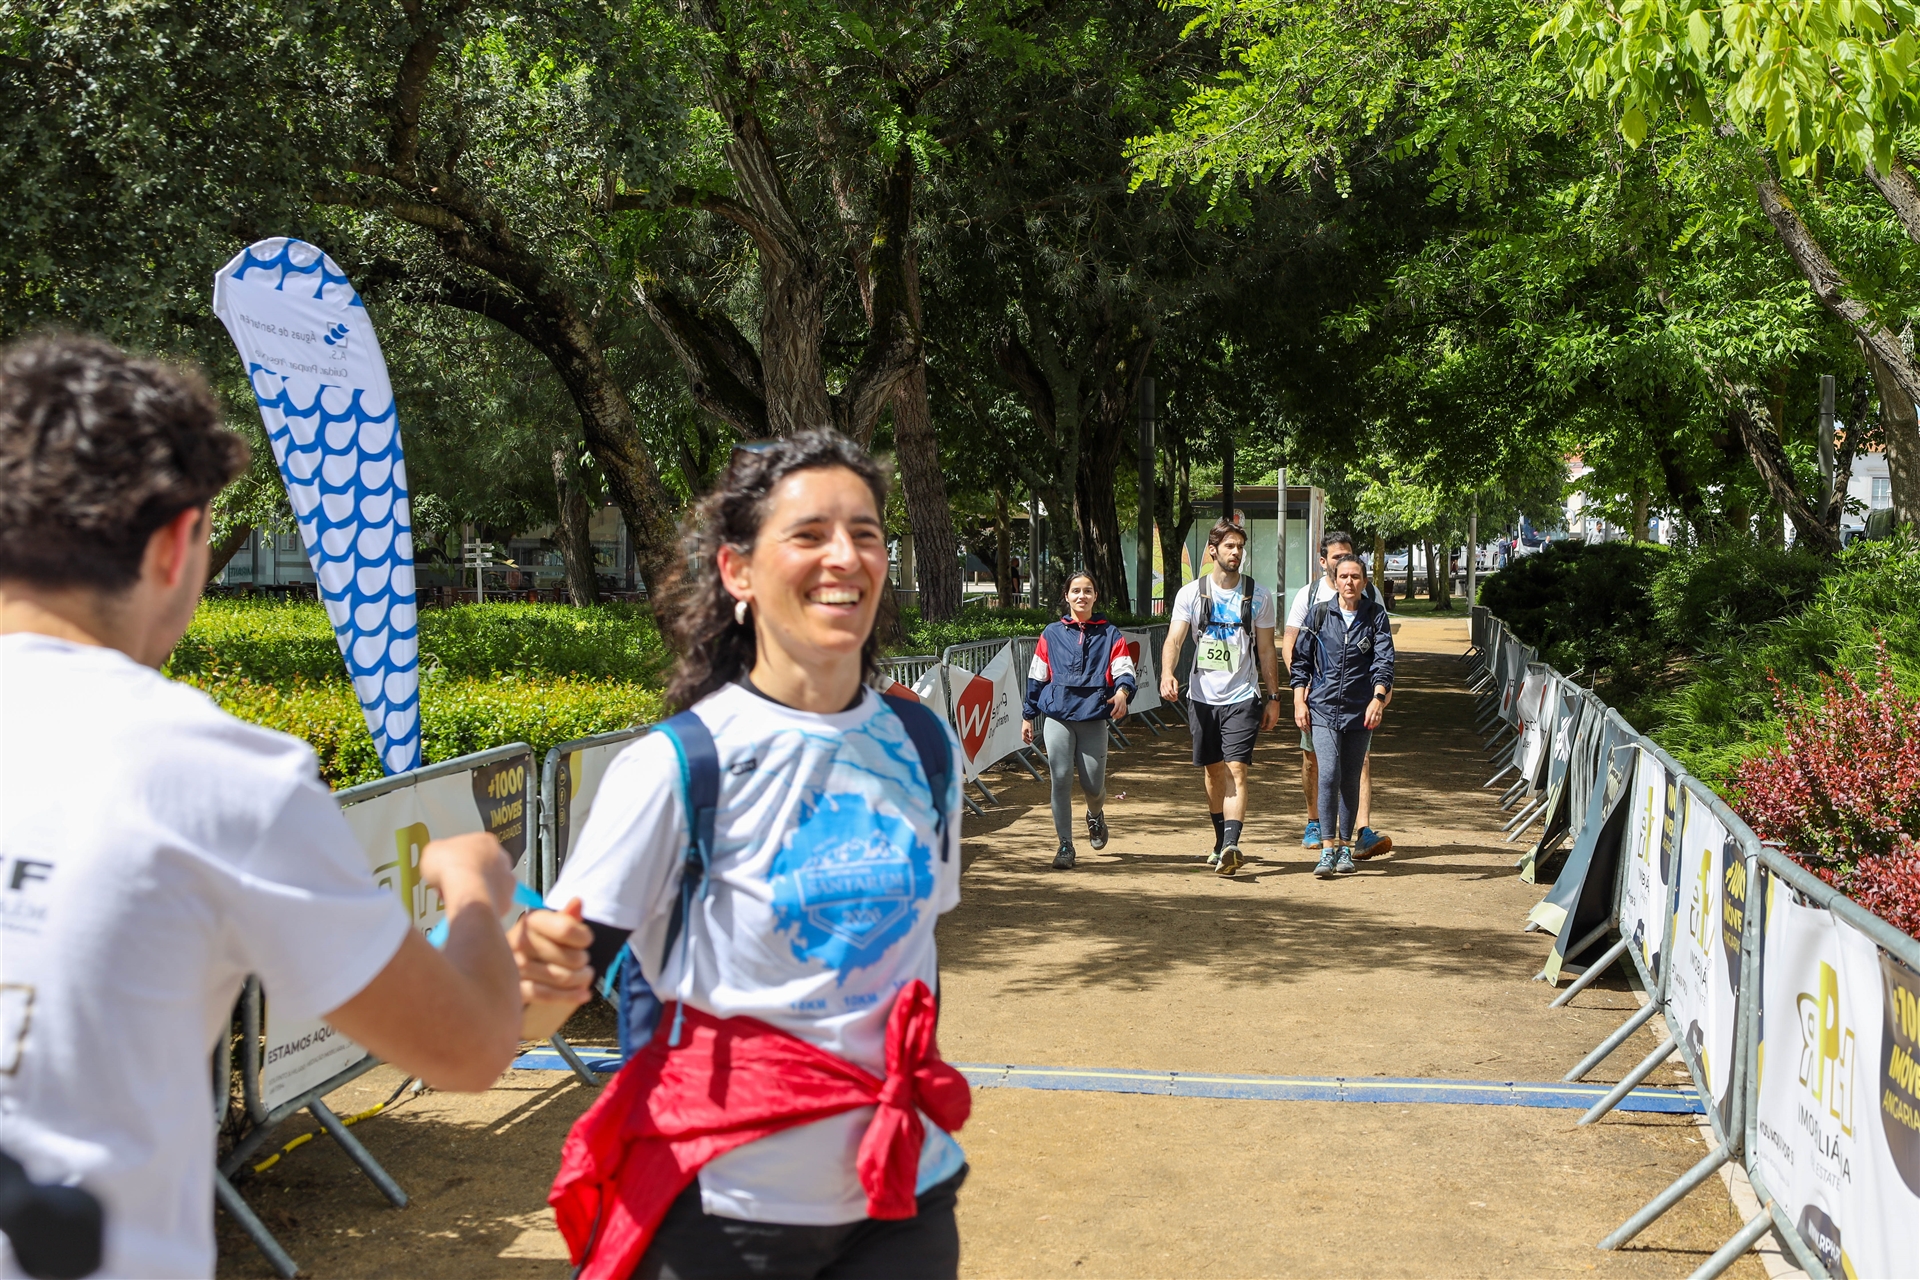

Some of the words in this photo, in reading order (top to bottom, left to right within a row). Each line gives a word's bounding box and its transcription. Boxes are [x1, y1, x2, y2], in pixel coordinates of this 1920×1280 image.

[1207, 648, 1230, 661] 520
[488, 765, 524, 799] +1000
[490, 799, 523, 829] IMÓVEIS
[9, 859, 54, 890] F
[268, 1033, 312, 1065] ESTAMOS
